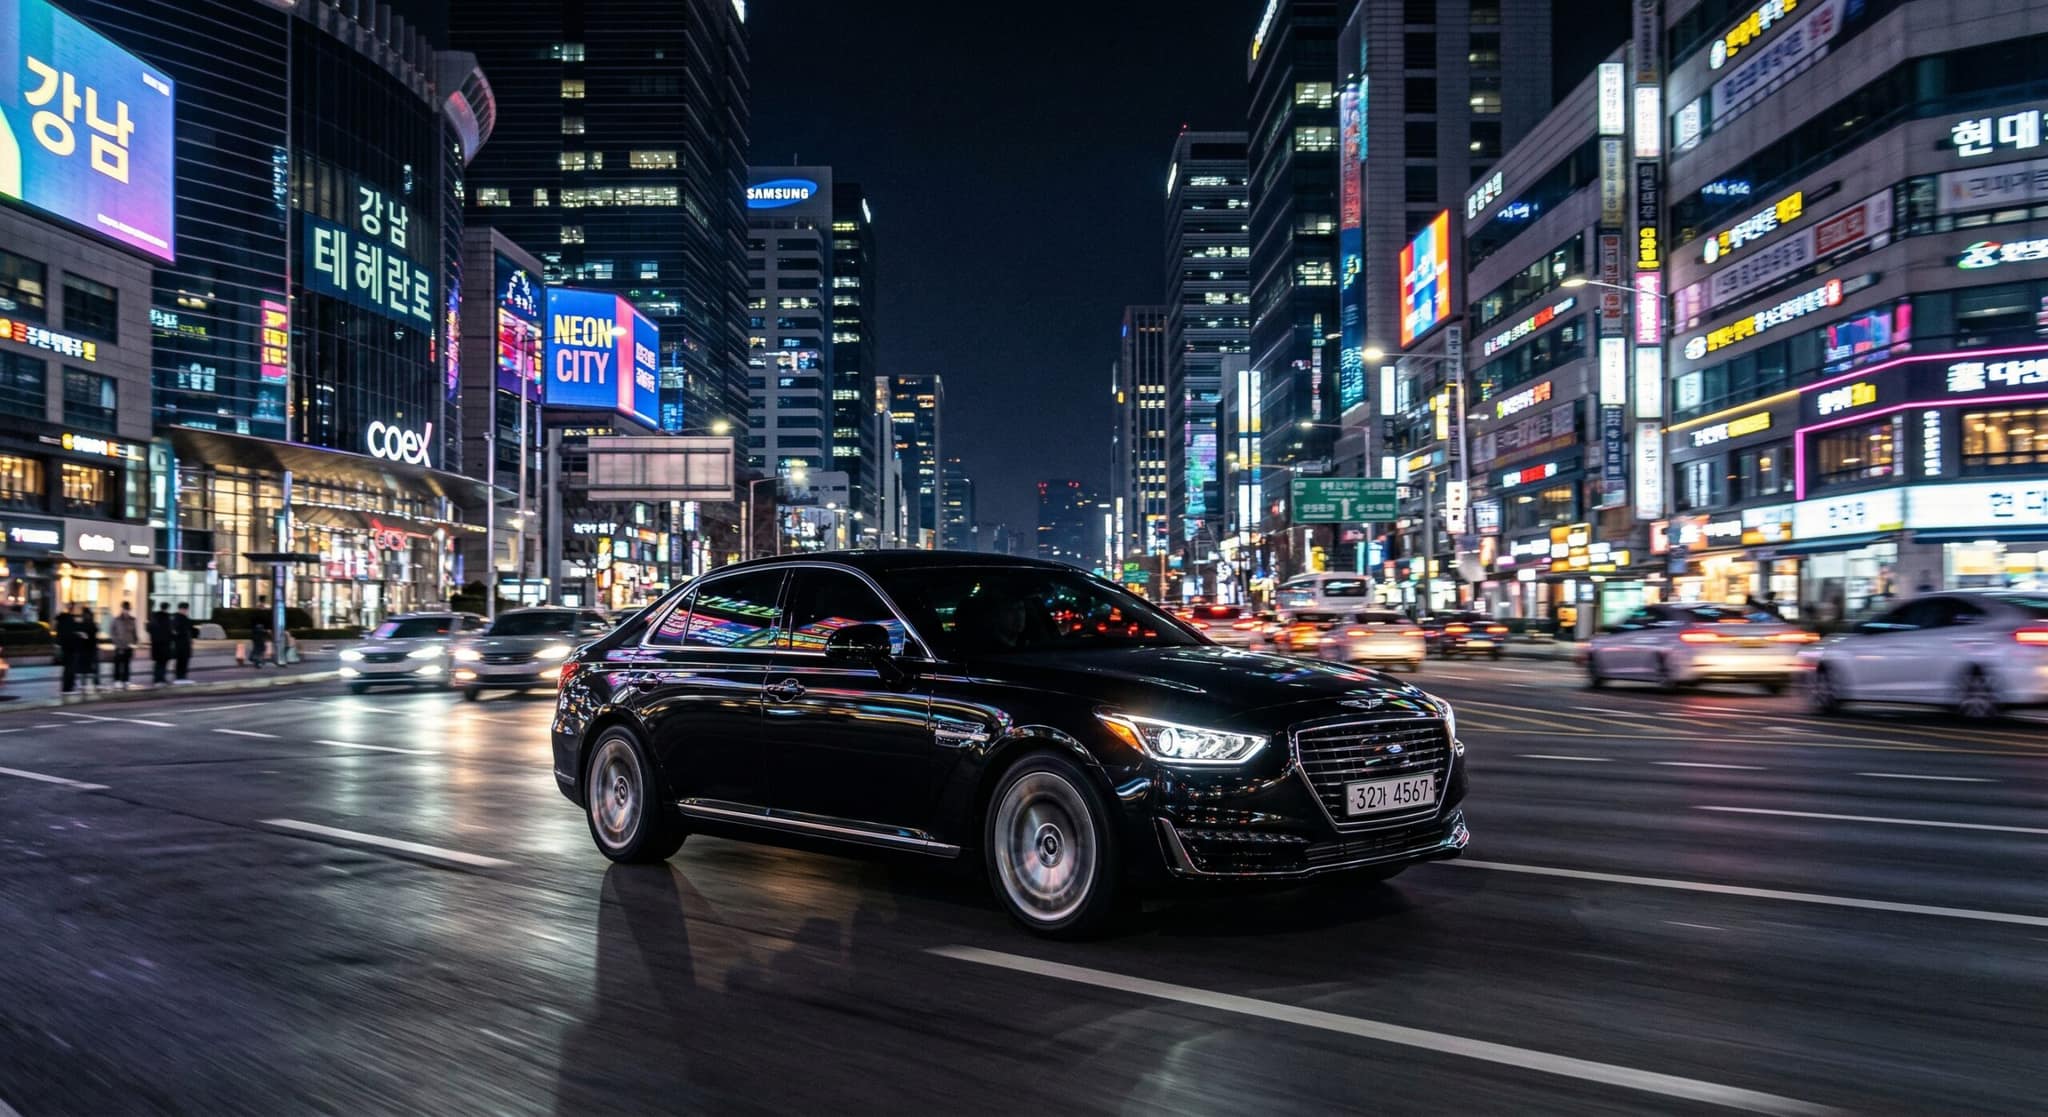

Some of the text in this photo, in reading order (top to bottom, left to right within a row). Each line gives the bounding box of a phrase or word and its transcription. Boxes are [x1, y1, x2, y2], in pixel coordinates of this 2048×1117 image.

[24, 55, 135, 185] 강남
[1951, 109, 2048, 157] 현대
[746, 187, 809, 200] SAMSUNG
[358, 185, 409, 249] 강남
[313, 226, 433, 323] 테헤란로
[554, 314, 613, 349] NEON
[556, 348, 610, 384] CITY
[1356, 779, 1429, 810] 32가 4567
